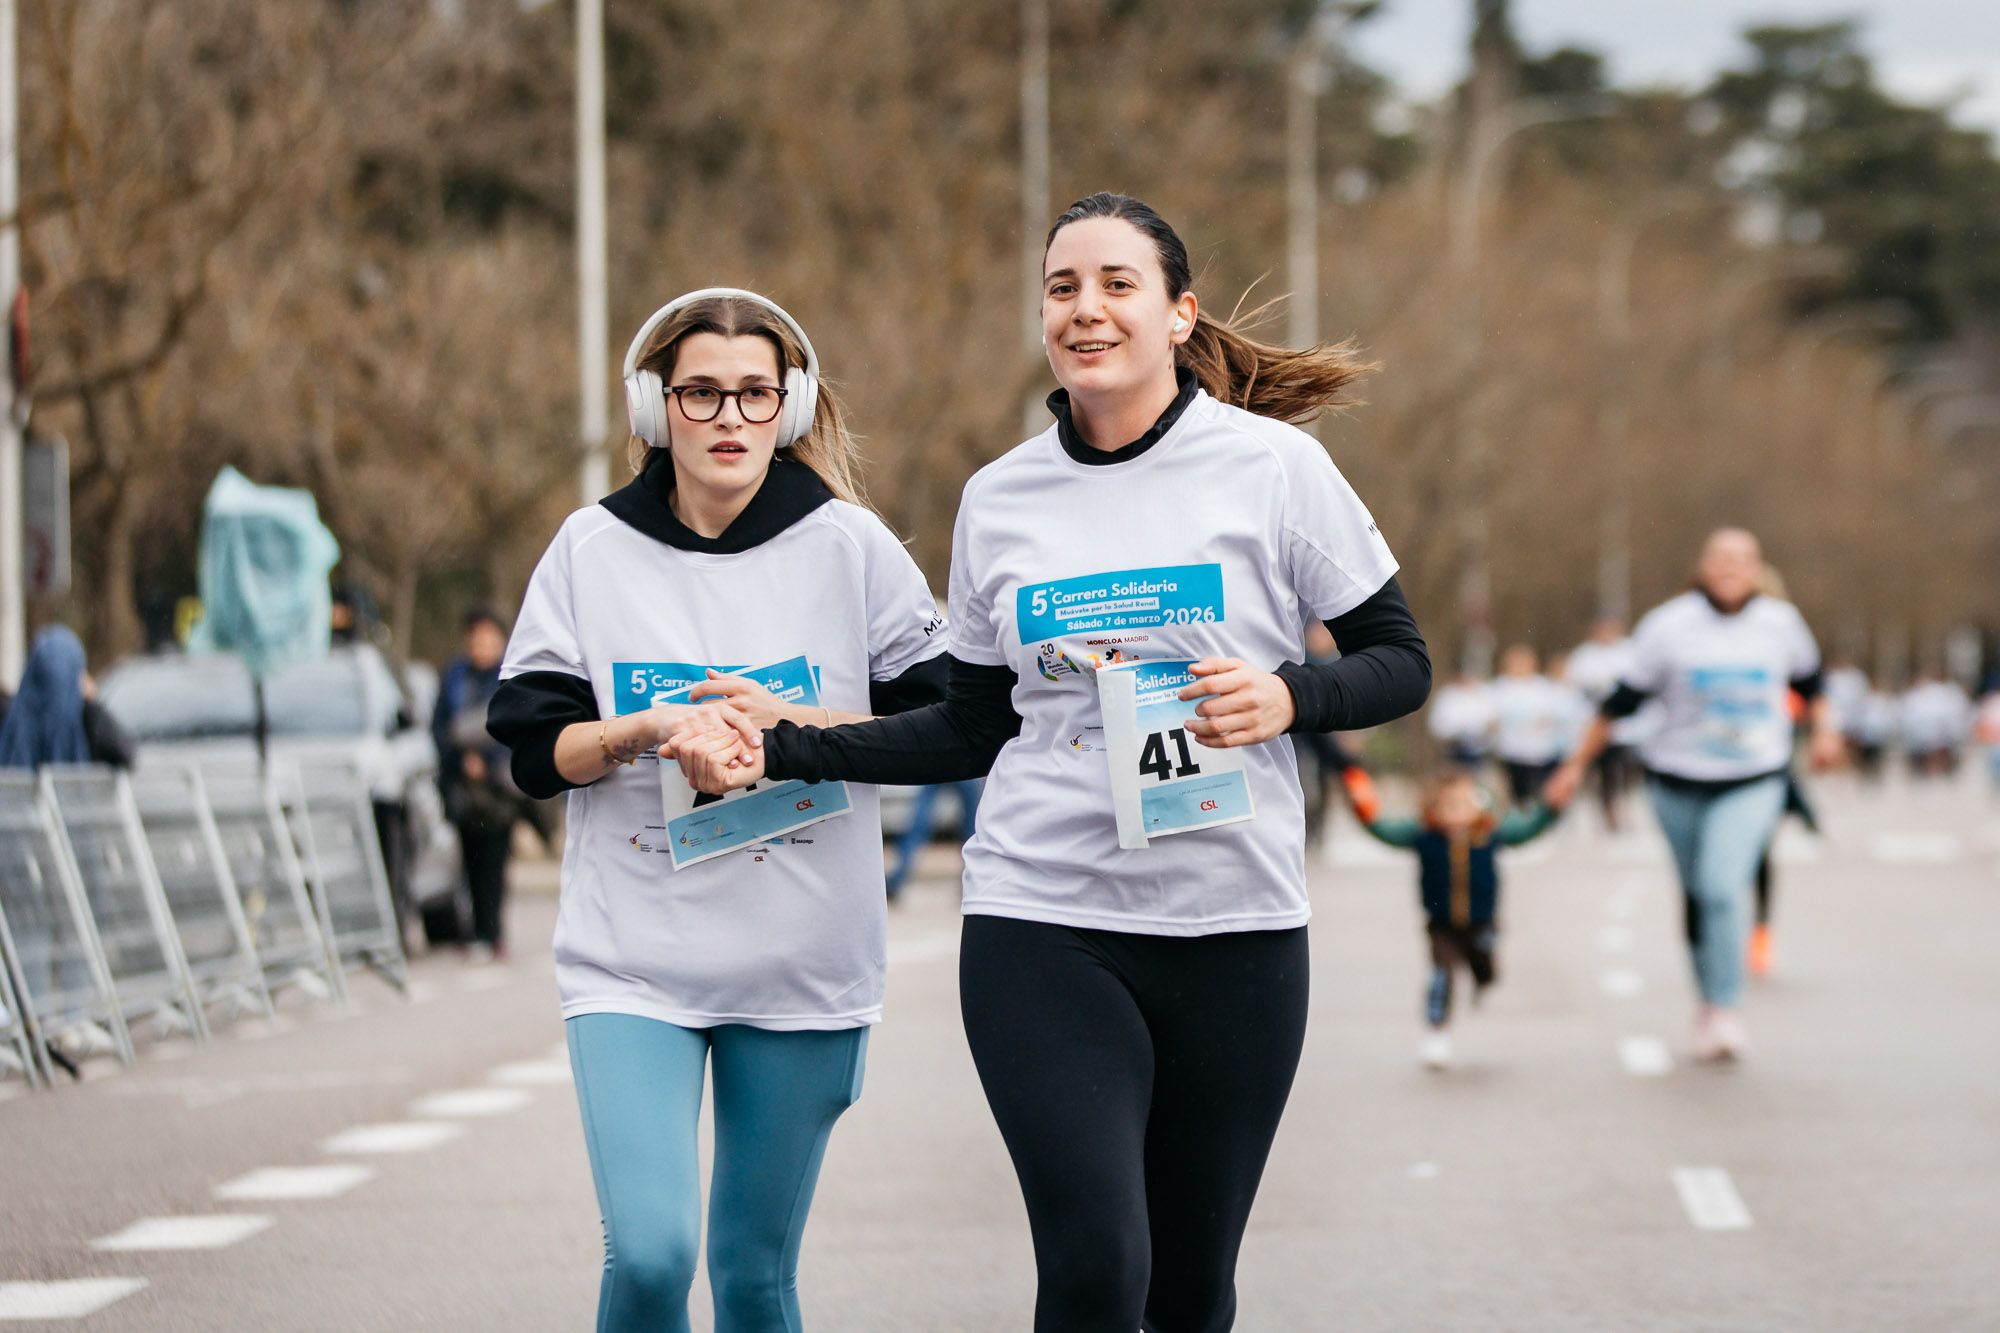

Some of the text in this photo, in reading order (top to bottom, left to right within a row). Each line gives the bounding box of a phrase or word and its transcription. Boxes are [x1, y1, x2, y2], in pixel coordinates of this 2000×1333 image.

[1052, 588, 1107, 605] Carrera
[1111, 578, 1178, 597] Solidaria
[1092, 606, 1103, 614] por
[1114, 600, 1133, 609] Salud
[1135, 599, 1156, 608] Renal
[1066, 605, 1216, 631] Sábado 7 de marzo 2026
[1086, 635, 1149, 646] MONCLOA MADRID
[1040, 643, 1055, 656] 20
[1136, 671, 1197, 691] Solidaria
[1139, 727, 1201, 782] 41
[796, 798, 815, 812] CSL
[1200, 799, 1218, 811] CSL
